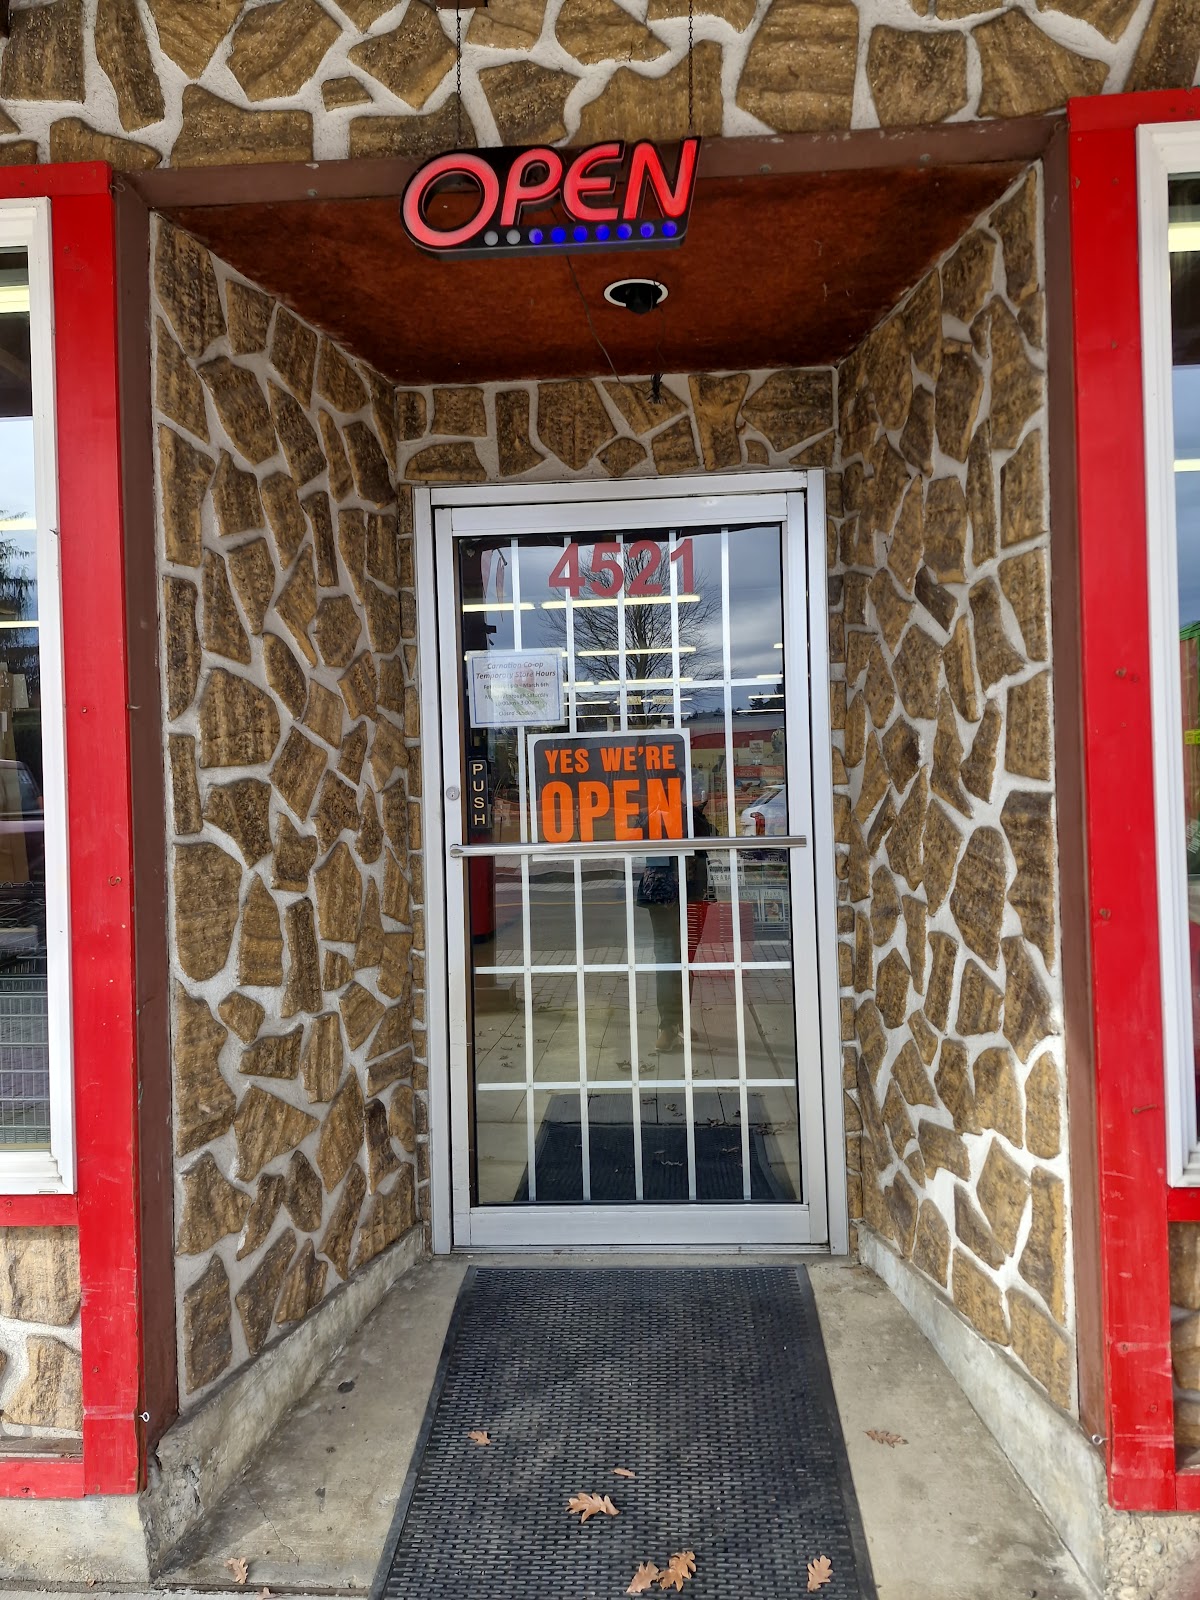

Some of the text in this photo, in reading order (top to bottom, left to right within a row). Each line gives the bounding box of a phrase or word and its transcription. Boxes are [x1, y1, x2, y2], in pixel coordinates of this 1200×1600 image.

[403, 139, 698, 247] OPEN
[548, 538, 694, 598] 4521
[476, 672, 514, 680] Temporary
[487, 661, 544, 670] Carnation Co-op
[544, 744, 676, 774] YES WE'RE
[472, 763, 486, 826] PUSH
[541, 777, 684, 844] OPEN
